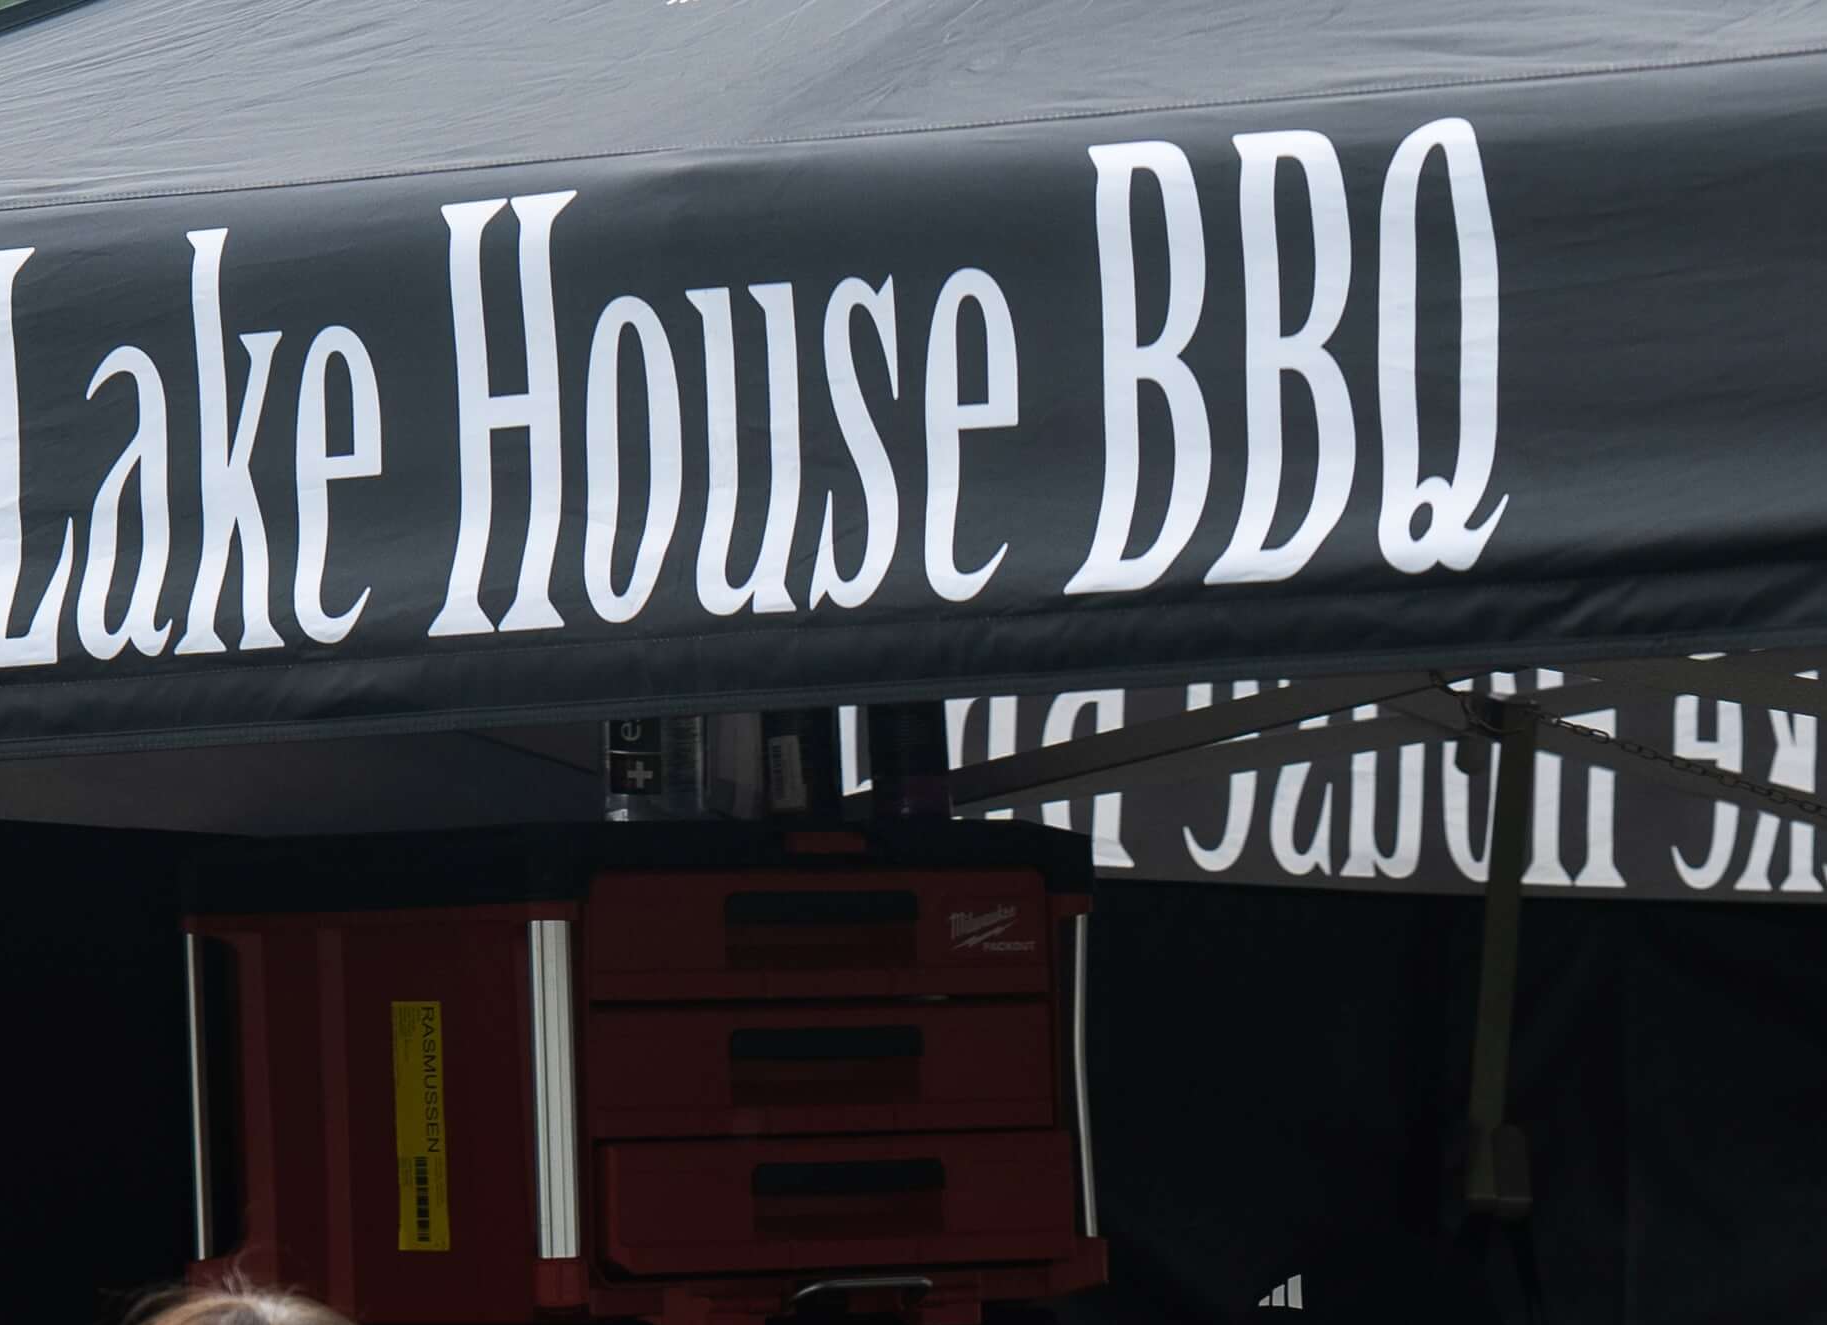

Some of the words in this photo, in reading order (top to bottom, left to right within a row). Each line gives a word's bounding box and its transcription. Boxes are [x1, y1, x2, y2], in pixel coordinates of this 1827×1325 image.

[427, 189, 1020, 637] House
[1063, 116, 1510, 597] BBQ
[419, 1004, 443, 1154] RASMUSSEN
